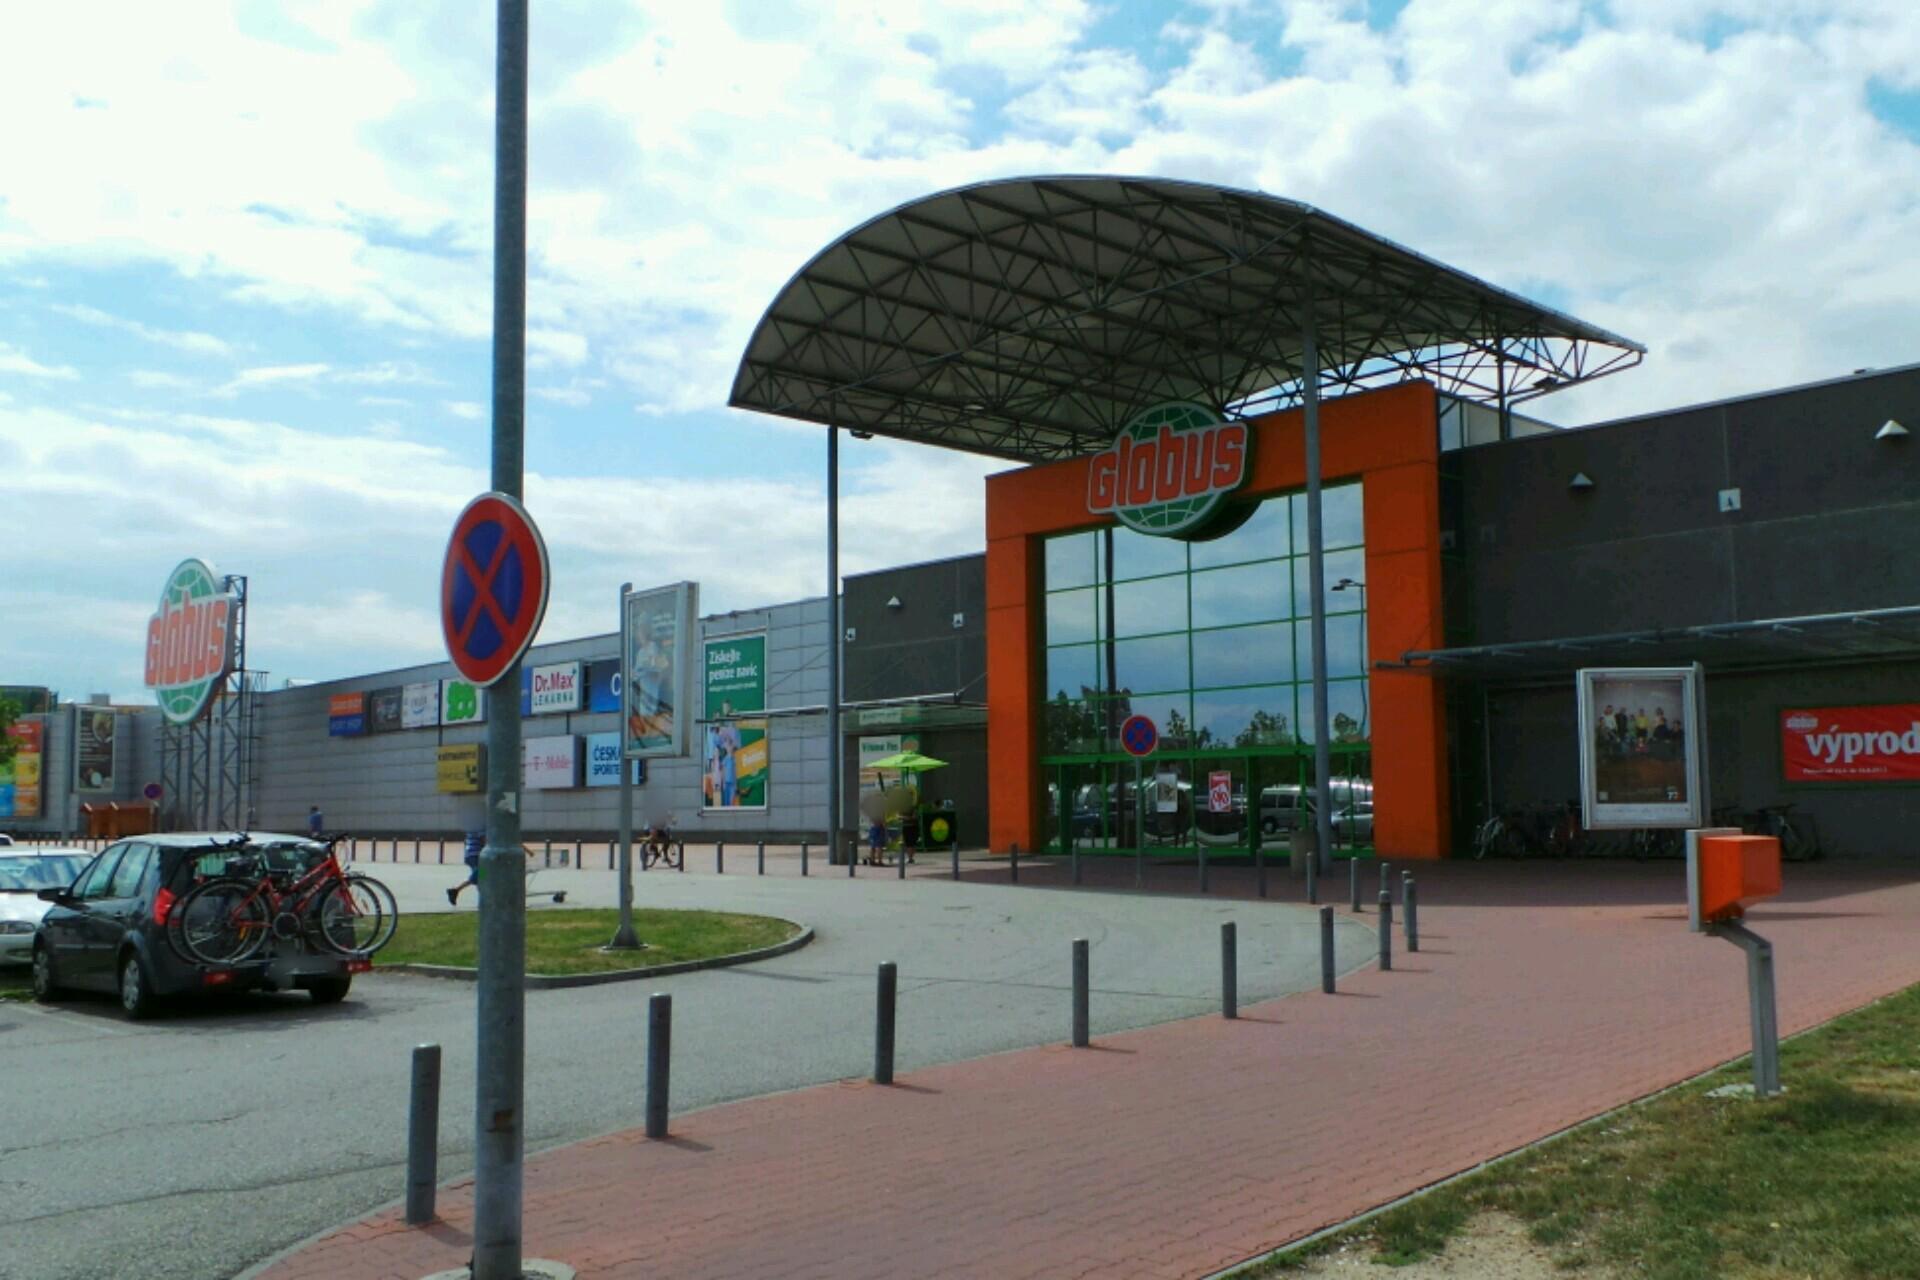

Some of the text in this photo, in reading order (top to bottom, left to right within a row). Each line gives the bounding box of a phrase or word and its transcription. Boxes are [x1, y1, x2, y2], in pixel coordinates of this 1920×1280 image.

[1090, 425, 1244, 509] Globus
[146, 590, 228, 687] Globus
[535, 671, 573, 692] Dr.Max
